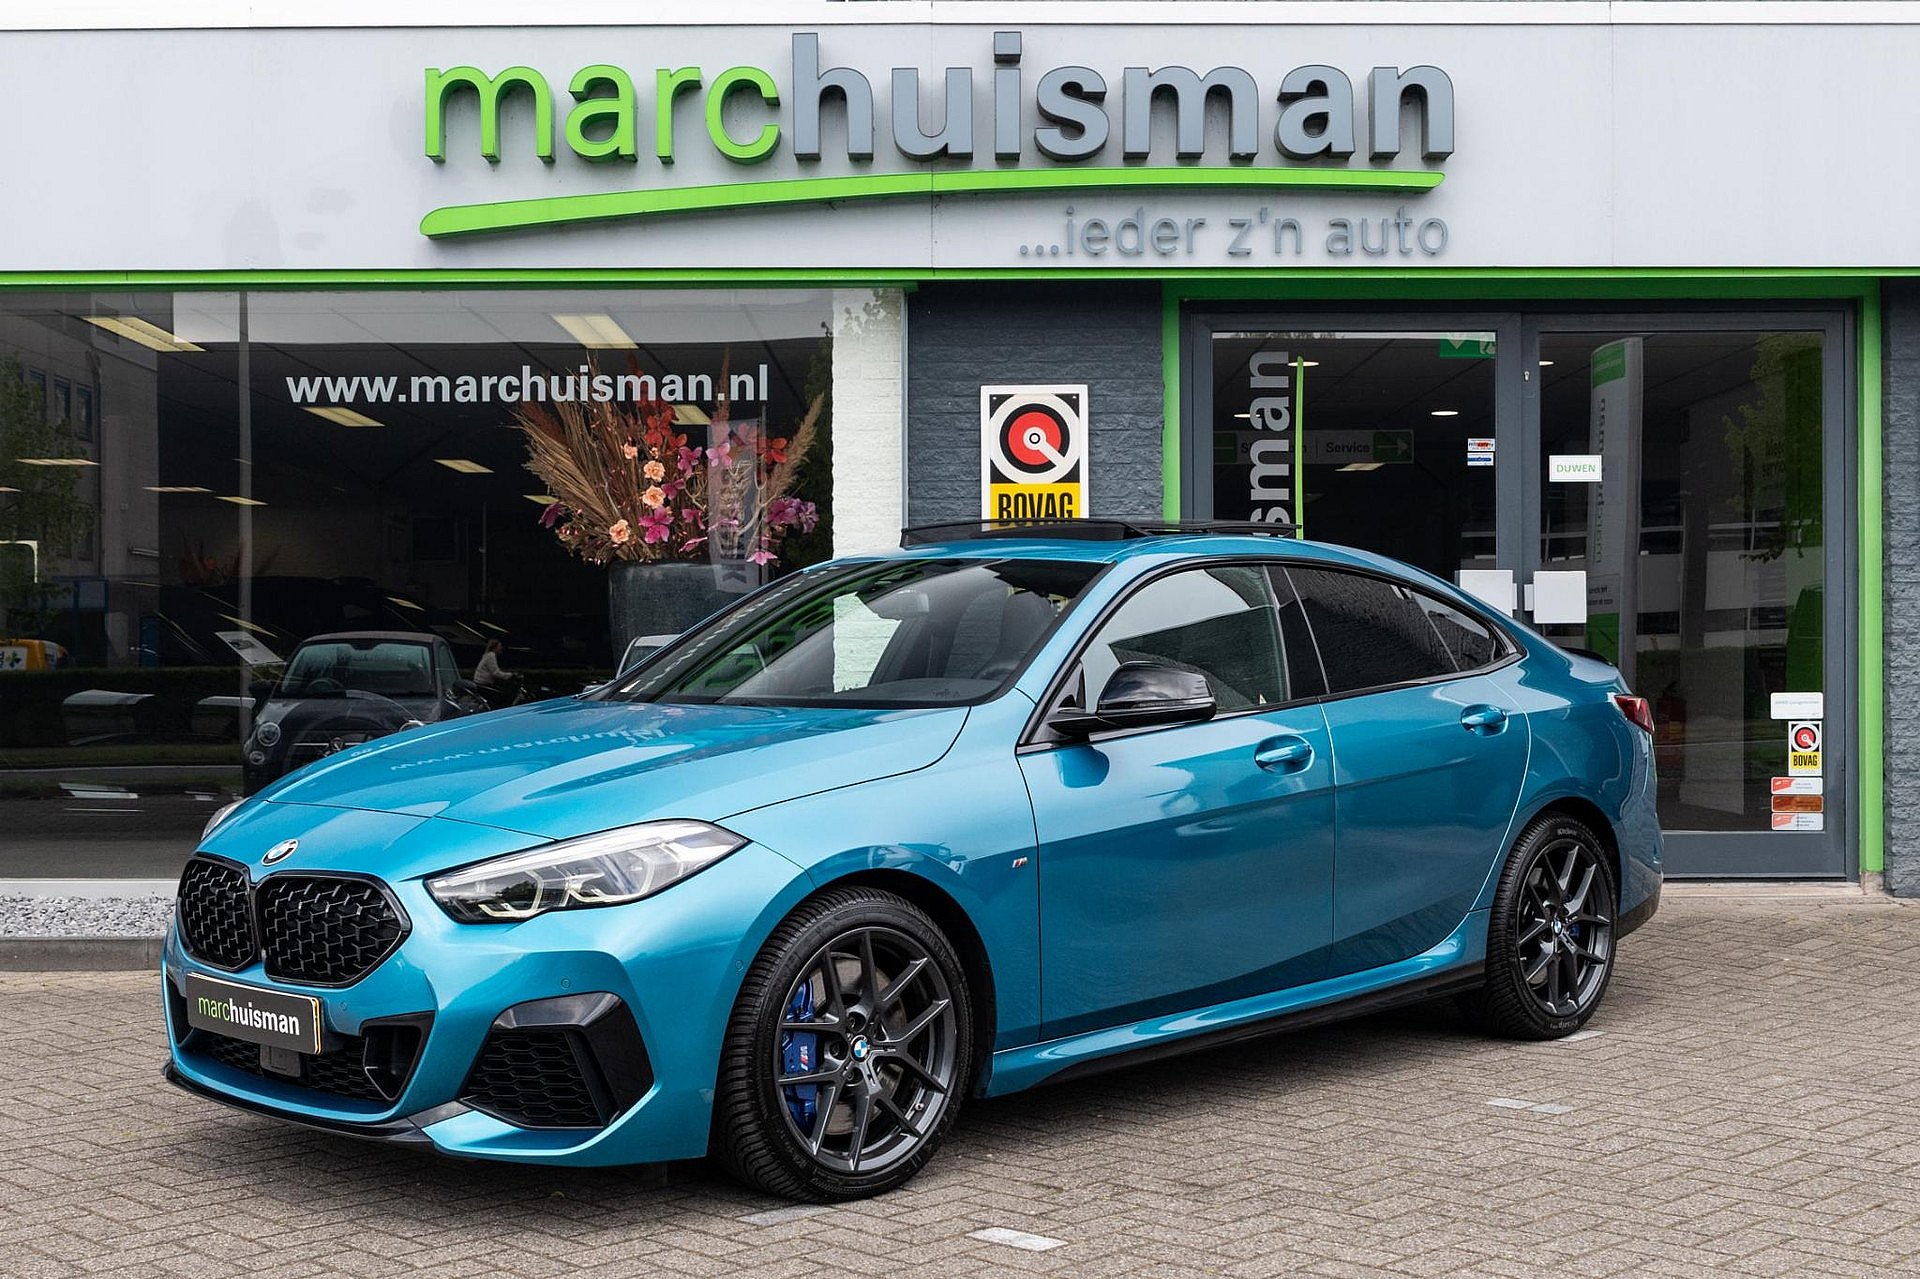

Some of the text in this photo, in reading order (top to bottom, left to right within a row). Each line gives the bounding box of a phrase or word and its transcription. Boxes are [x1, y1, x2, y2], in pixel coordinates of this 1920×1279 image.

[424, 32, 1455, 162] marchuisman
[1228, 207, 1302, 255] z'n
[1325, 206, 1450, 256] auto
[285, 364, 768, 403] www.marchuisman.nl
[1326, 441, 1370, 454] Service
[1556, 464, 1596, 473] DUWEN
[998, 492, 1074, 520] BOVAG
[1793, 754, 1818, 767] BOVAG
[198, 997, 301, 1036] marchuisman
